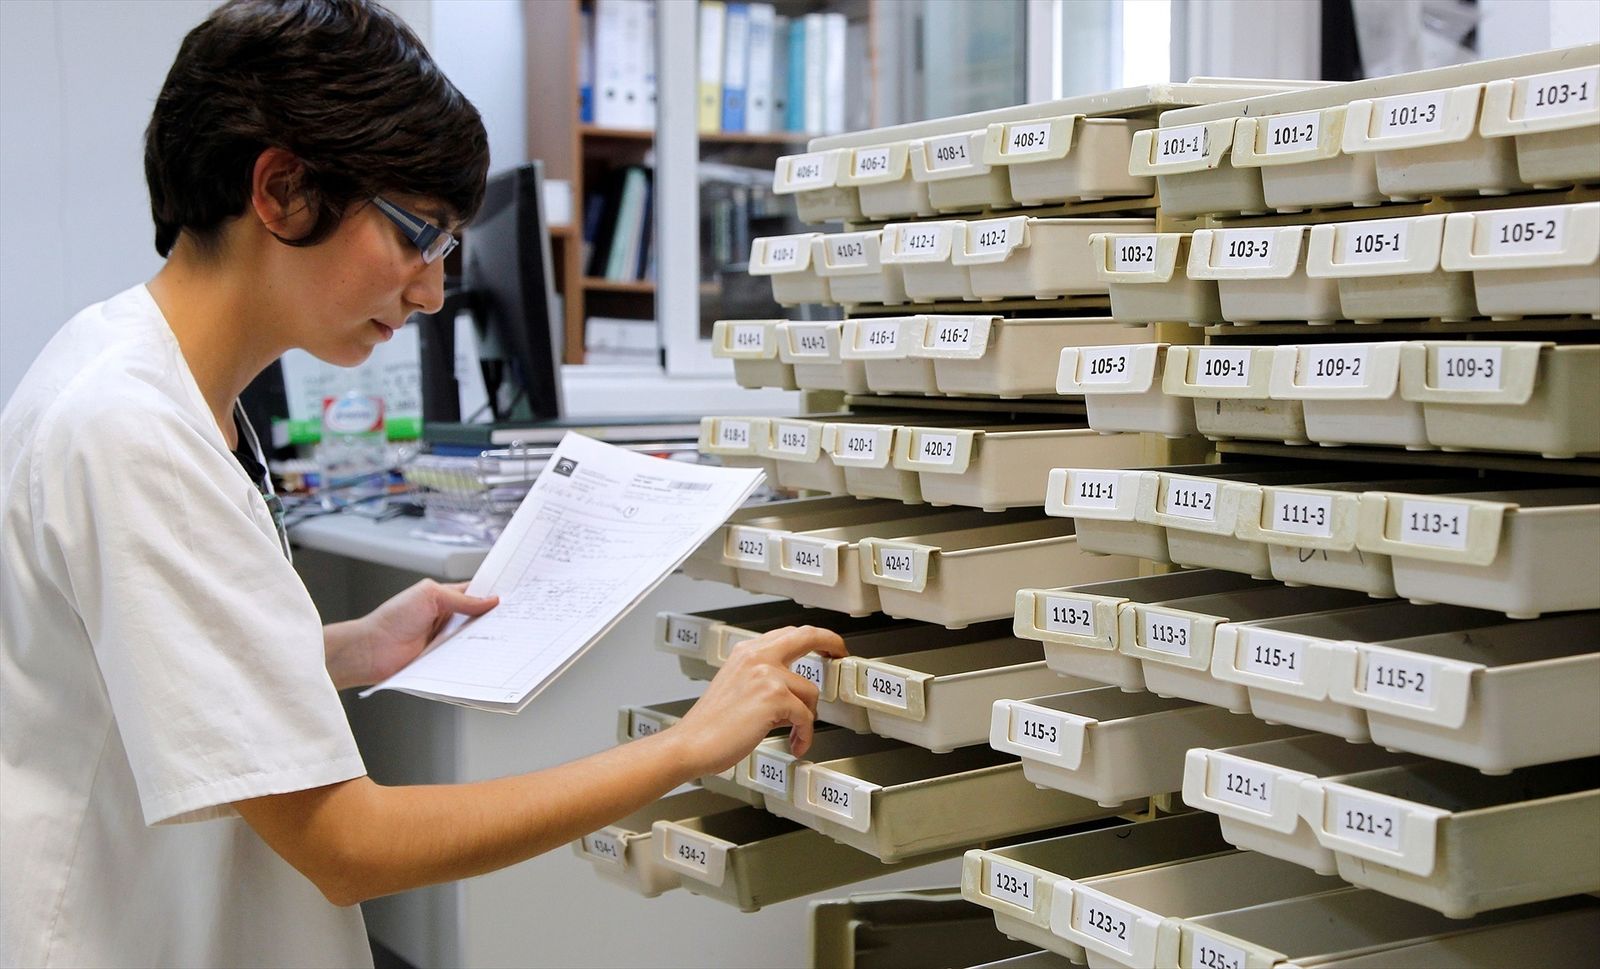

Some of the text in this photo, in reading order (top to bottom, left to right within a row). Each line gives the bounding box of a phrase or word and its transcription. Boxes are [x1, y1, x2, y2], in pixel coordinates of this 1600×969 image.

[1536, 81, 1588, 107] 103-1
[1389, 103, 1437, 127] 101-3
[1013, 130, 1045, 148] 408-2
[1274, 124, 1313, 145] 101-2
[937, 144, 966, 161] 408-1
[1163, 136, 1199, 156] 101-1
[796, 164, 819, 179] 406-1
[860, 155, 887, 171] 406-2
[909, 234, 935, 249] 412-1
[979, 229, 1006, 247] 412-2
[1500, 220, 1556, 244] 105-2
[837, 242, 863, 258] 410-2
[1228, 240, 1269, 258] 103-3
[1354, 233, 1400, 254] 105-1
[772, 247, 794, 262] 410-1
[1121, 245, 1153, 263] 103-2
[737, 332, 761, 346] 414-1
[801, 335, 826, 350] 414-2
[869, 330, 895, 345] 416-1
[940, 328, 969, 343] 416-2
[1090, 356, 1126, 375] 105-3
[1205, 358, 1245, 377] 109-1
[1316, 357, 1361, 377] 109-2
[1446, 357, 1494, 379] 109-3
[722, 428, 747, 442] 418-1
[782, 432, 806, 448] 418-2
[848, 437, 873, 452] 420-1
[924, 441, 952, 457] 420-2
[1080, 481, 1114, 500] 111-1
[1174, 489, 1212, 510] 111-2
[1282, 504, 1325, 526] 111-3
[1410, 512, 1460, 536] 113-1
[738, 540, 763, 555] 422-2
[795, 551, 821, 568] 424-1
[885, 555, 910, 571] 424-2
[1053, 606, 1090, 627] 113-2
[1152, 623, 1187, 646] 113-3
[1255, 645, 1295, 670] 115-1
[796, 664, 820, 683] 428-1
[1376, 666, 1425, 693] 115-2
[872, 677, 903, 698] 428-2
[1023, 720, 1057, 743] 115-3
[760, 764, 784, 783] 432-1
[1226, 773, 1267, 801] 121-1
[821, 786, 849, 808] 432-2
[1345, 810, 1393, 838] 121-2
[678, 844, 706, 865] 434-2
[996, 872, 1029, 898] 123-1
[1088, 908, 1126, 941] 123-2
